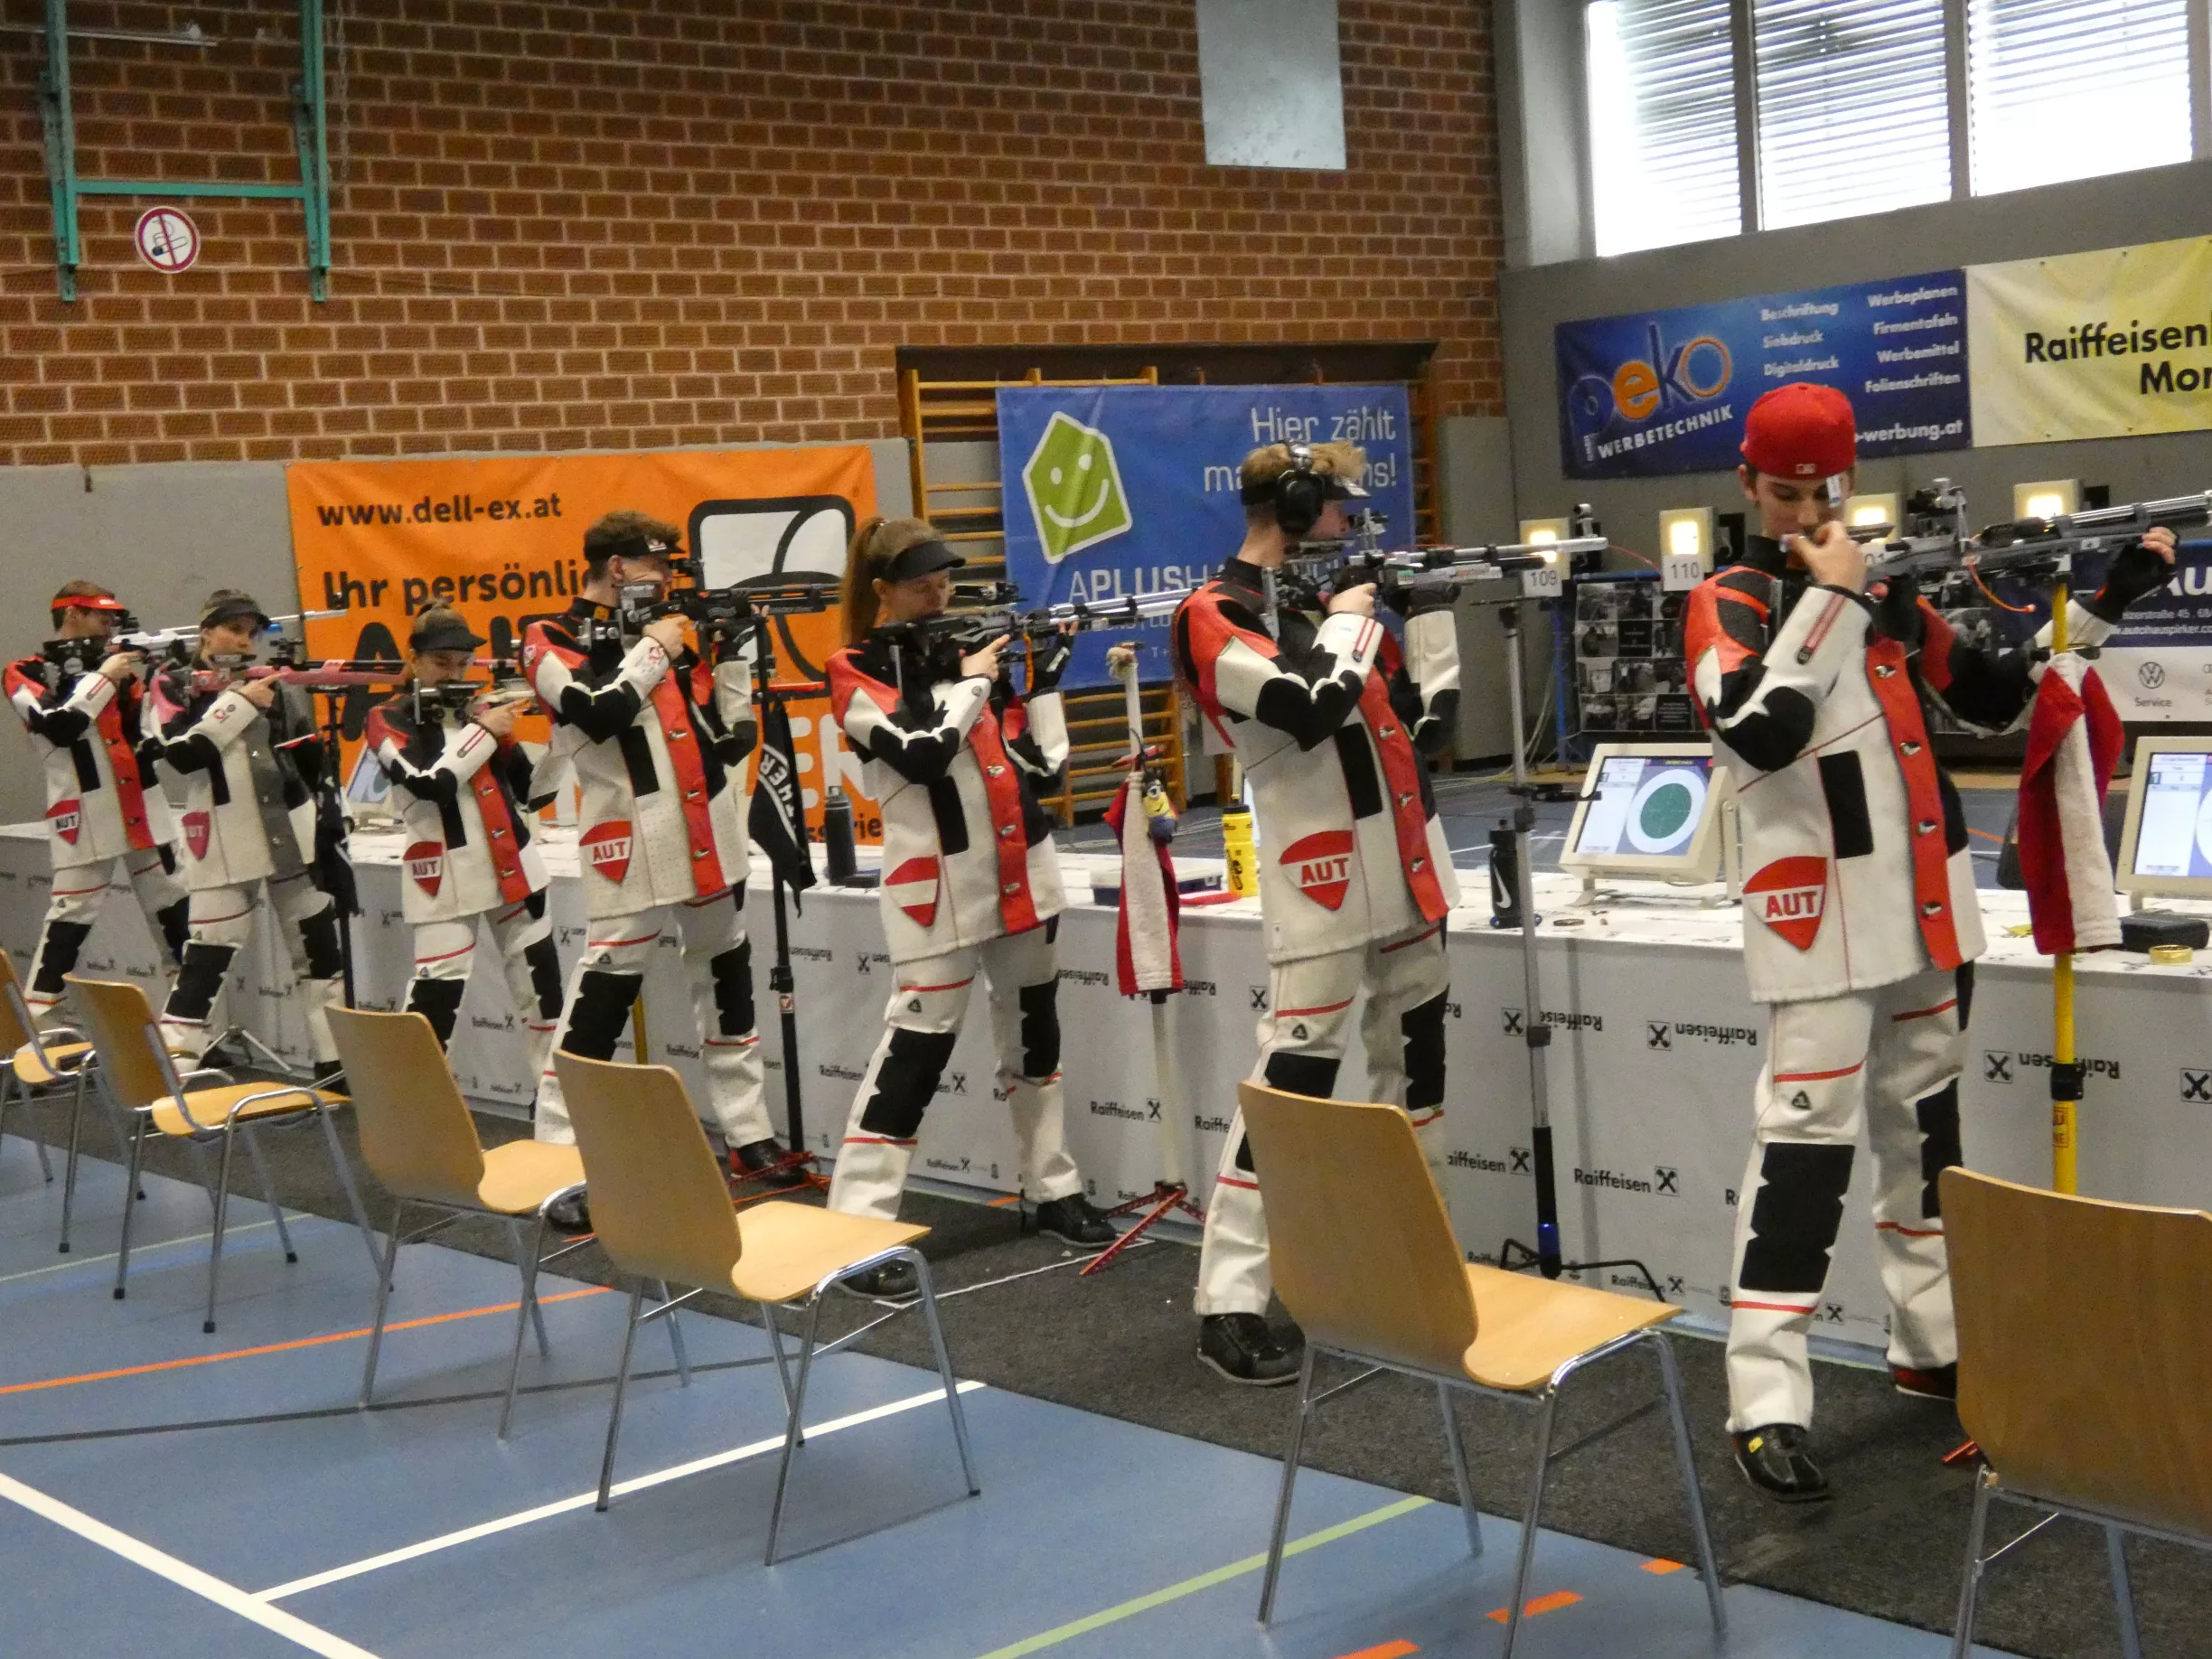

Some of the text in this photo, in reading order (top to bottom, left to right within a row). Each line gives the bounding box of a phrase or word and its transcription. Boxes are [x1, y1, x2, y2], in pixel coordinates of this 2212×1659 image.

[1866, 286, 1959, 308] Werbeplanen
[1760, 302, 1840, 322] Beschriftung
[1872, 312, 1959, 336] Firmentafeln
[1762, 329, 1824, 349] Siebdruck
[2025, 310, 2212, 363] Raiffeisen
[1876, 340, 1961, 363] Werbemittel
[1864, 371, 1962, 394] Folienschriften
[1251, 406, 1396, 443] Hier zählt
[1598, 403, 1734, 460] WERBETECHNIK
[317, 492, 562, 527] www.dell-ex.at
[1531, 569, 1558, 588] 109
[1670, 561, 1701, 580] 110
[323, 570, 389, 610] Ihr
[2133, 697, 2173, 708] Service
[55, 814, 78, 831] AUT
[592, 838, 628, 863] AUT
[412, 859, 438, 876] AUT
[1301, 858, 1349, 885] AUT
[1765, 890, 1818, 919] AUT
[1675, 1021, 1757, 1046] Raiffeisen
[1090, 1100, 1146, 1122] Raiffeisen
[1195, 1114, 1230, 1134] Raiffe
[1574, 1167, 1652, 1194] Raiffeisen
